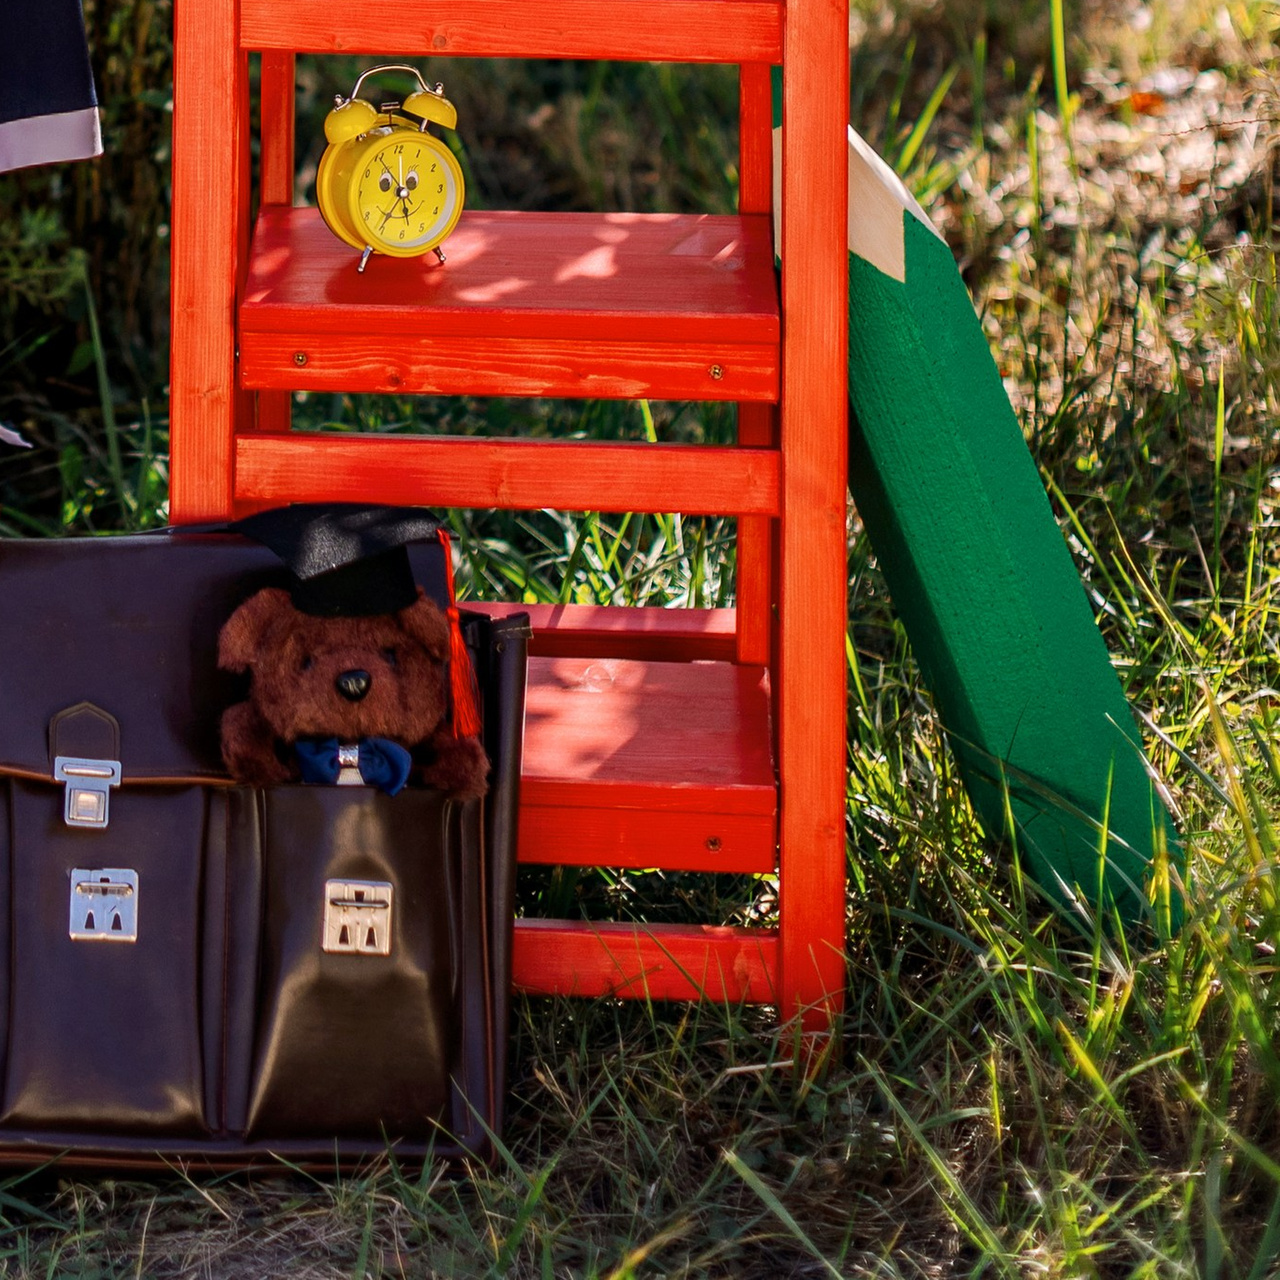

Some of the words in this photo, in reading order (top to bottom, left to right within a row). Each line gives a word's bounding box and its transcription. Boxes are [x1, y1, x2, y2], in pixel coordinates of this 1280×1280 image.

[393, 145, 404, 154] 12
[430, 163, 437, 173] 2
[437, 184, 444, 194] 3
[419, 223, 425, 233] 5
[399, 230, 405, 240] 6
